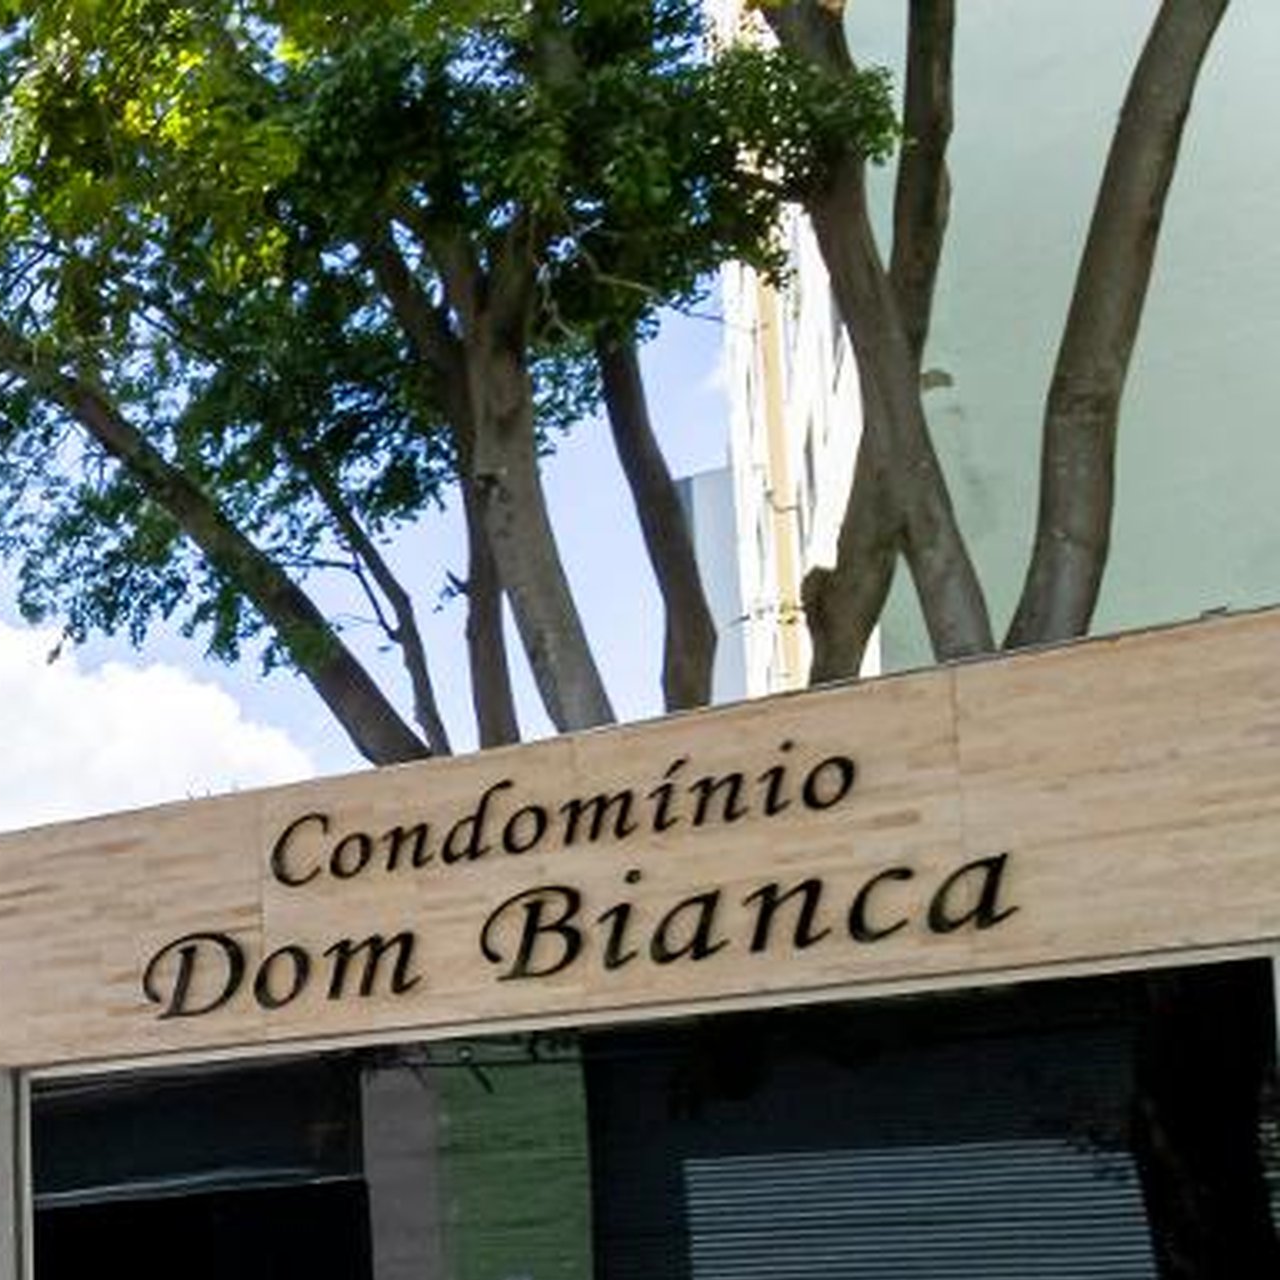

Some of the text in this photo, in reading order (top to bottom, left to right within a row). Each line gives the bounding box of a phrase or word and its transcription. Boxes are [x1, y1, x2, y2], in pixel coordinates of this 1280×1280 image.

[270, 739, 859, 888] Condomínio
[142, 851, 1021, 1021] Dom Bianca
